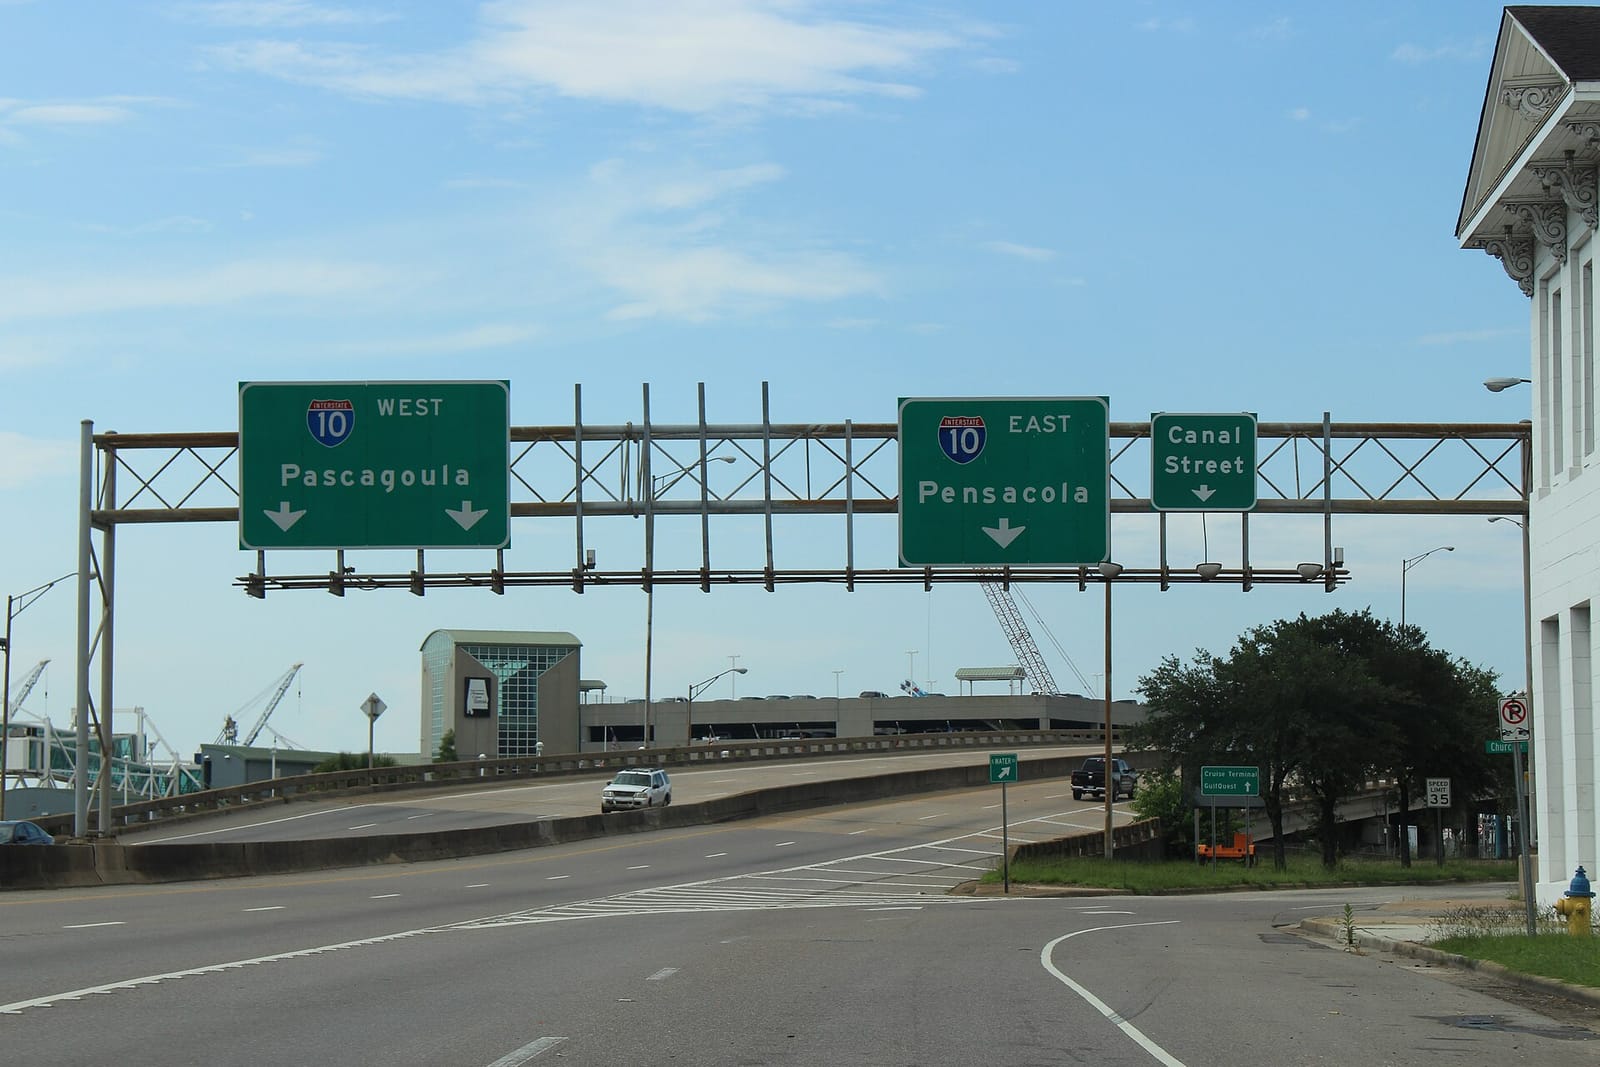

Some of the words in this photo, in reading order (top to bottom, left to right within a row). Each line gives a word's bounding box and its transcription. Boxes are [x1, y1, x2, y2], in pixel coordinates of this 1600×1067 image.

[313, 402, 349, 410] INTERSTATE
[377, 399, 443, 417] WEST
[317, 411, 347, 438] 10
[944, 418, 980, 427] INTERSTATE
[1009, 415, 1071, 433] EAST
[949, 428, 980, 455] 10
[1168, 425, 1241, 444] Canal
[1164, 455, 1244, 474] Street
[281, 463, 470, 493] Pascagoula
[918, 480, 1089, 504] Pensacola
[1490, 742, 1515, 752] Churc
[1228, 770, 1258, 778] Terminal
[1204, 782, 1237, 790] GulfQuest
[1430, 793, 1449, 805] 35
